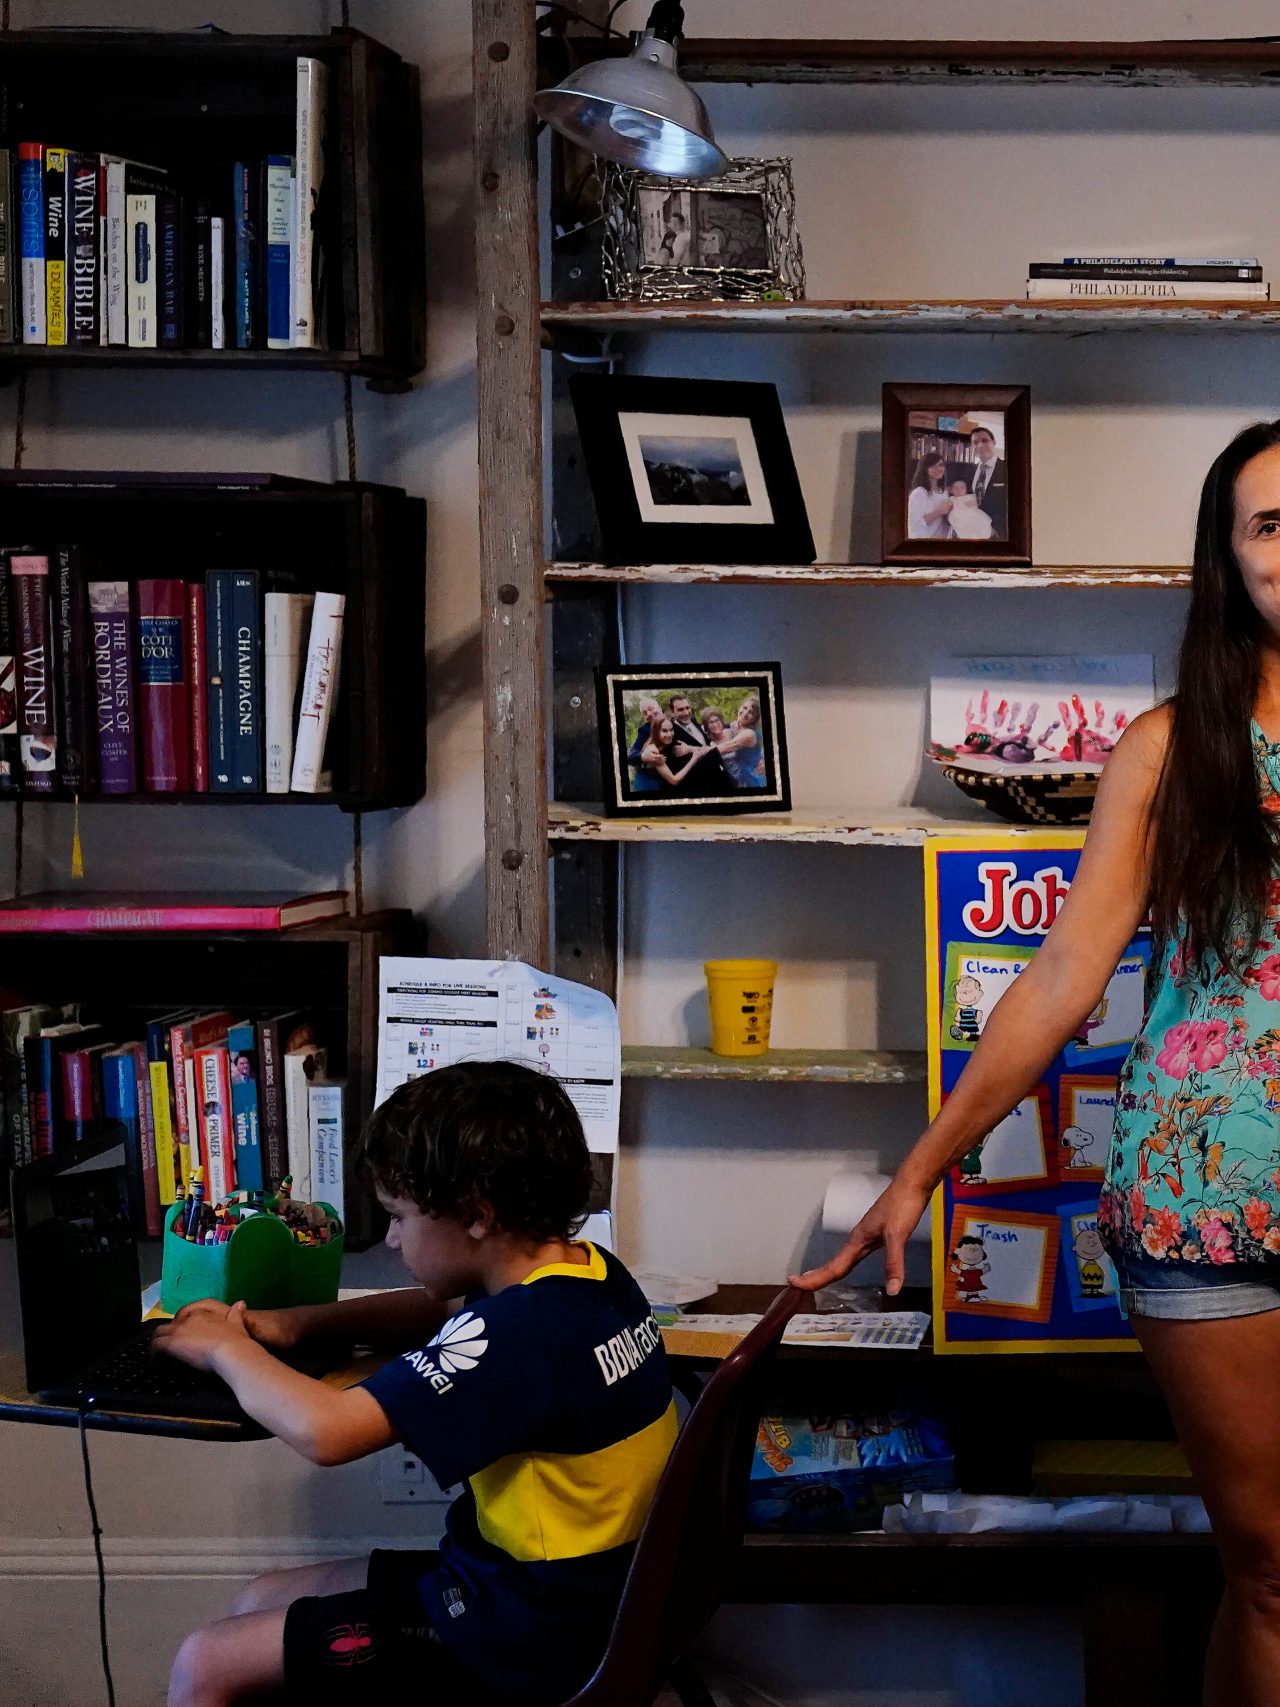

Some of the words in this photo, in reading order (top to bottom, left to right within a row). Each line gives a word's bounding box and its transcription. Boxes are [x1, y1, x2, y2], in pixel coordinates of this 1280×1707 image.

[49, 196, 63, 238] Wine
[72, 171, 97, 236] WINE
[1073, 258, 1080, 266] A
[1080, 258, 1140, 266] PHILADELPHIA
[1140, 258, 1166, 268] STORY
[73, 256, 97, 331] BIBLE
[164, 290, 175, 314] BAR
[1070, 282, 1178, 297] PHILADELPHIA
[60, 566, 70, 595] World
[62, 629, 73, 653] Wine
[113, 620, 126, 651] THE
[22, 646, 48, 727] WINE
[93, 621, 114, 735] BORDEAUX
[115, 656, 129, 706] WINES
[238, 626, 253, 736] CHAMPAGNE
[117, 711, 130, 734] OF
[966, 960, 1009, 976] Clean
[1114, 963, 1144, 977] inner
[204, 1058, 218, 1099] CHEESE
[417, 1058, 435, 1068] 123
[1079, 1095, 1116, 1108] Laund
[208, 1118, 222, 1158] PRIMER
[236, 1112, 250, 1147] wine
[328, 1127, 339, 1151] Food
[14, 1134, 24, 1168] ITALY
[315, 1128, 330, 1185] Companion
[327, 1152, 339, 1185] Lover's
[976, 1223, 1018, 1243] Trash
[401, 1350, 454, 1396] AWEI
